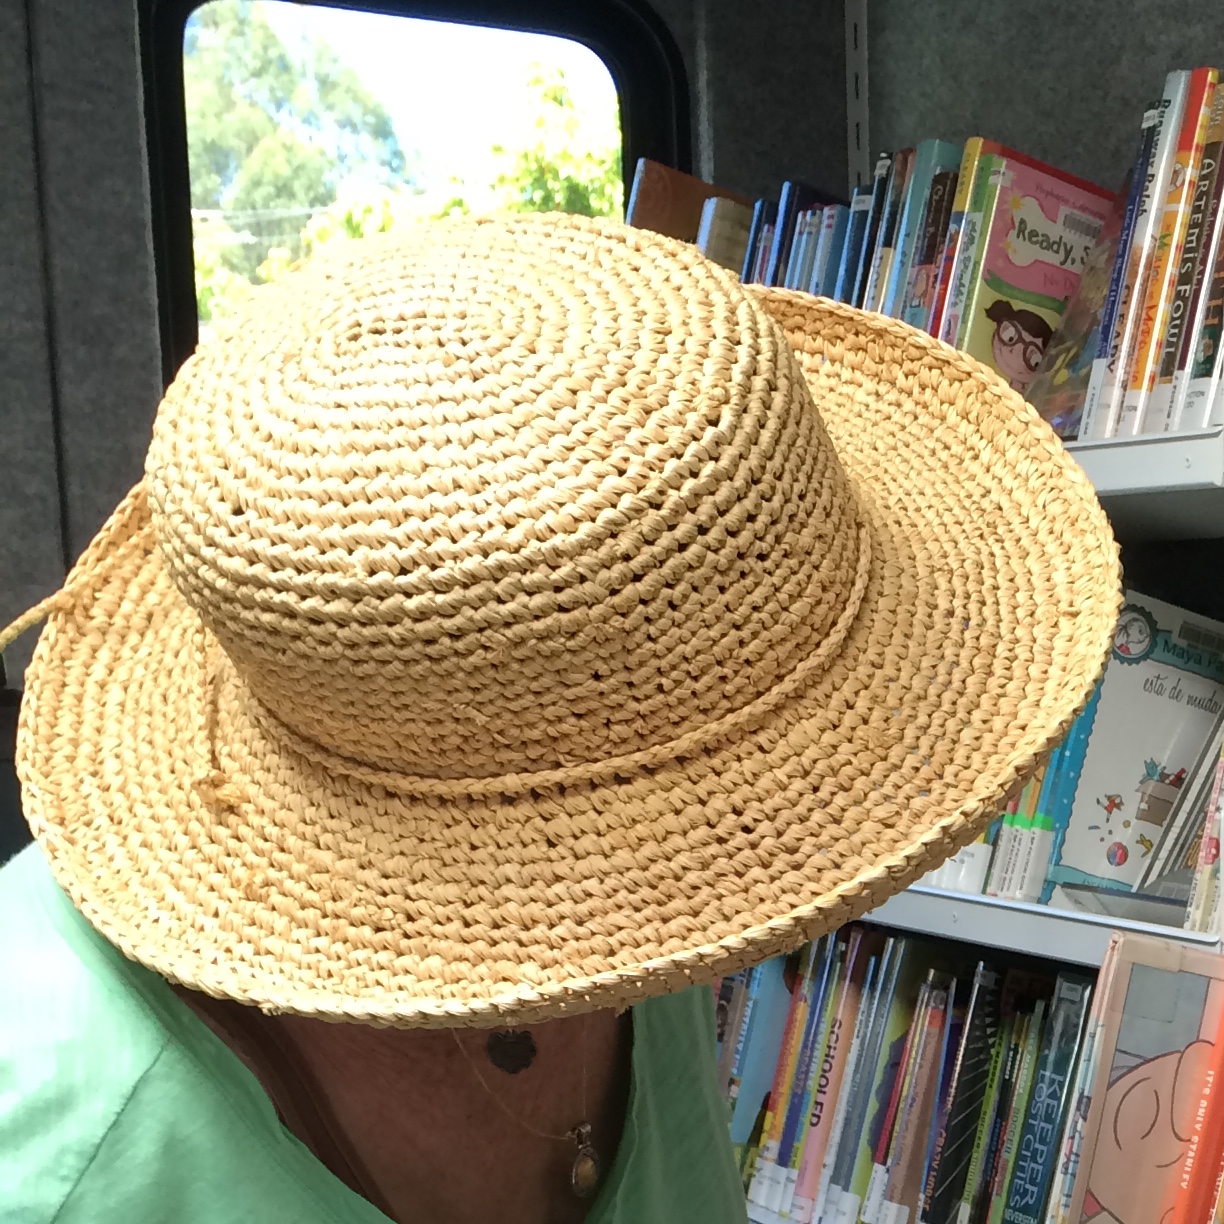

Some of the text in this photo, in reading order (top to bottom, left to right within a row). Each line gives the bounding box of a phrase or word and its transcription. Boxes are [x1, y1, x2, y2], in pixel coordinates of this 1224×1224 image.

[1150, 99, 1171, 168] Runaway
[1138, 173, 1155, 216] Ralph
[1016, 218, 1076, 266] Ready,
[1163, 638, 1202, 666] Maya
[1143, 674, 1183, 703] está de
[810, 1016, 843, 1128] SCHOOLED
[1009, 1072, 1050, 1208] LOST CITIES
[1017, 1073, 1064, 1208] KEEPER
[1181, 1071, 1215, 1189] IT'S ONLY STANLEY
